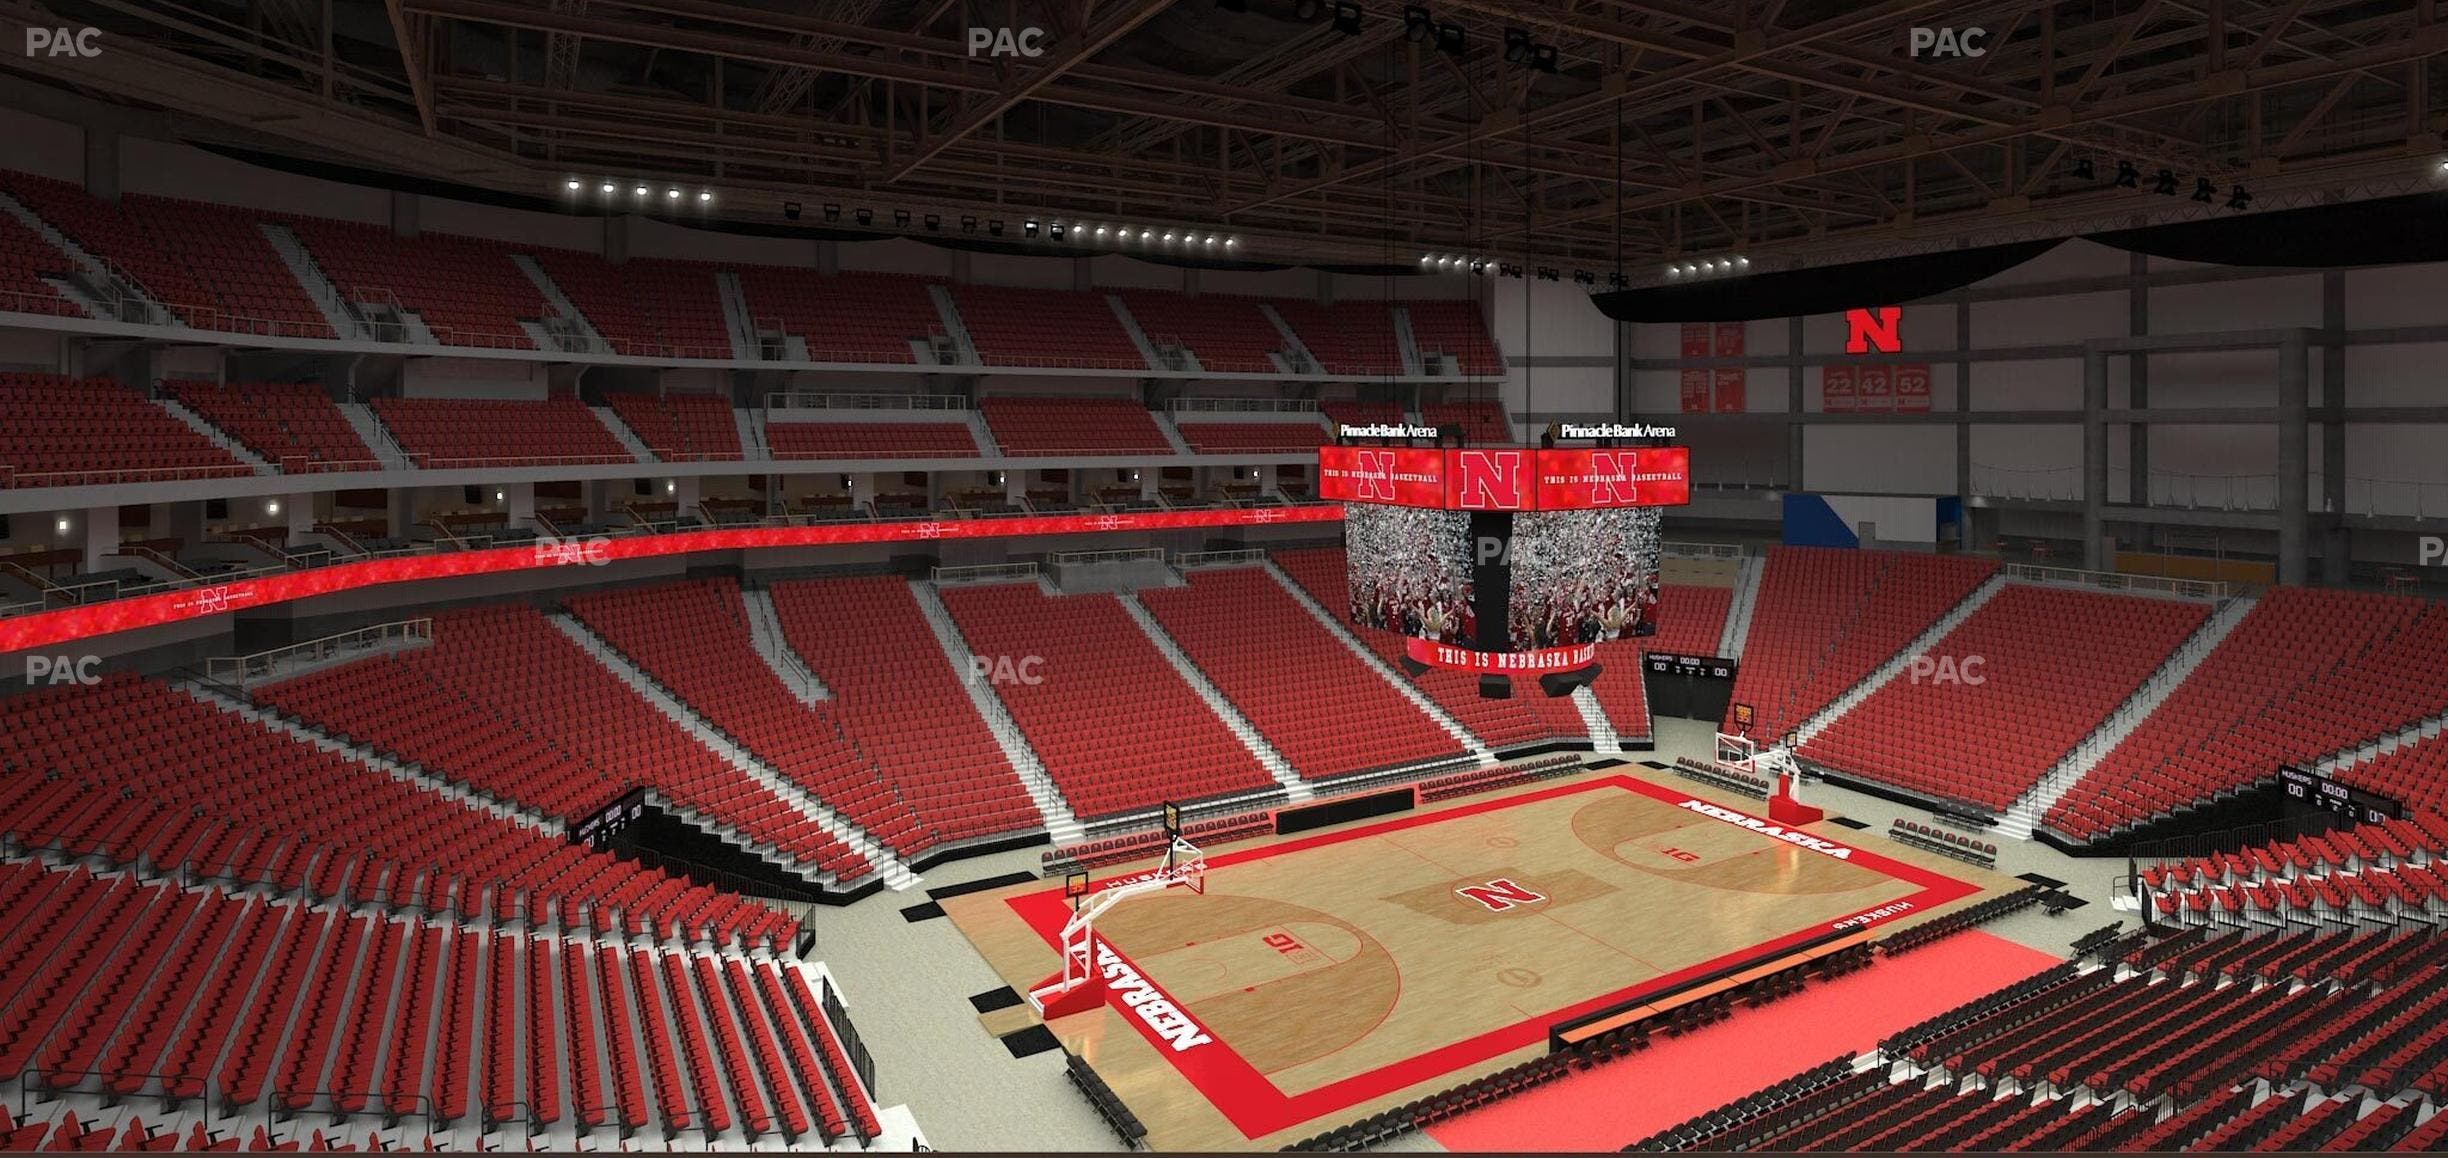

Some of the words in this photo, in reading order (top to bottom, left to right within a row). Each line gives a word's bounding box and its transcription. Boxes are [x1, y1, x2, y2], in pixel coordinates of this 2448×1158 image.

[1845, 306, 1903, 354] N
[1825, 378, 1852, 394] 22
[1861, 377, 1888, 394] 42
[1900, 377, 1926, 393] 52
[1643, 425, 1676, 438] Arena
[1358, 450, 1396, 501] N
[1461, 451, 1520, 509] N
[1592, 452, 1637, 503] N
[1438, 647, 1467, 666] THIS
[1474, 652, 1489, 667] IS
[1498, 653, 1568, 669] NEBRASKA
[1654, 662, 1666, 670] 00
[1714, 668, 1727, 676] 00
[2281, 769, 2312, 786] HUSKERS
[2321, 782, 2348, 800] 00:00
[2288, 783, 2304, 798] 00
[1678, 798, 1852, 861] NEBRASKA
[1455, 877, 1547, 912] N
